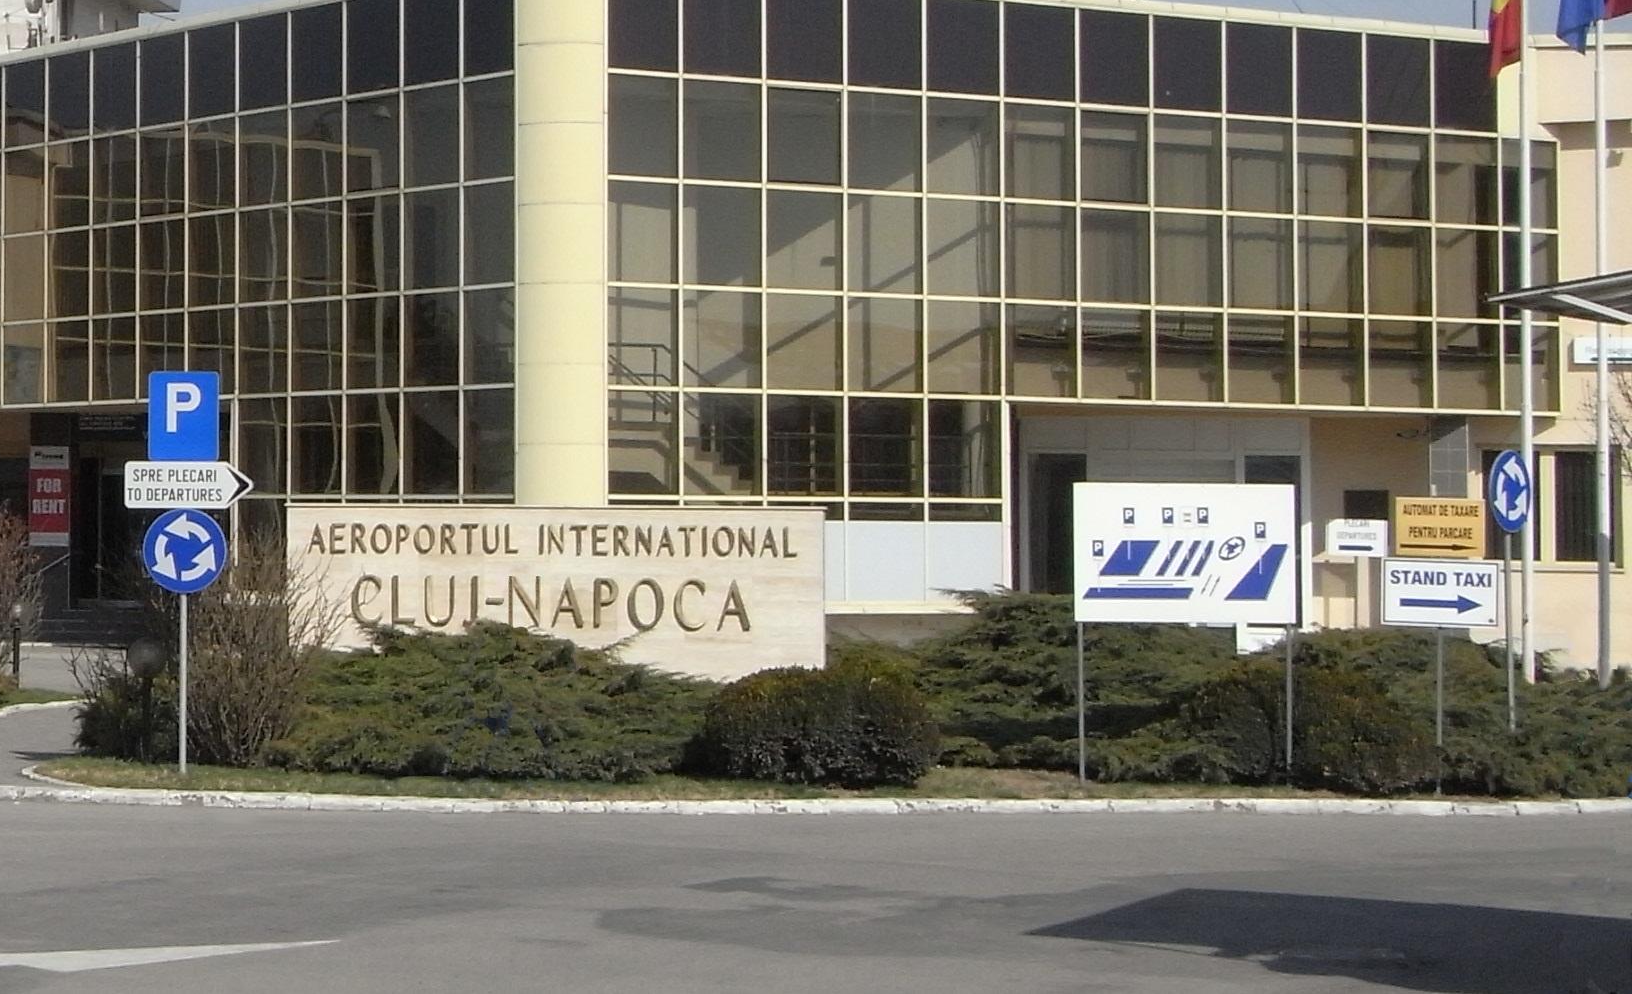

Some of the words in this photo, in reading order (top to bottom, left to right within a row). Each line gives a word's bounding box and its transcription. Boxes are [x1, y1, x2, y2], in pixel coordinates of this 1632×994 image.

[166, 382, 201, 433] P
[133, 469, 163, 482] SPRE
[168, 469, 217, 482] PLECARI
[36, 478, 62, 493] FOR
[128, 488, 142, 501] TO
[147, 488, 223, 502] DEPARTURES
[32, 499, 66, 514] RENT
[1403, 504, 1436, 516] AUTOMAT
[1439, 505, 1449, 516] DE
[1451, 505, 1479, 517] TAXARE
[1408, 526, 1438, 539] PENTRU
[1440, 527, 1473, 539] PARCARE
[307, 523, 518, 555] AEROPORTUL
[538, 524, 798, 558] INTERNATIONAL
[1390, 569, 1447, 586] STAND
[1453, 572, 1492, 587] TAXI
[351, 574, 752, 632] CLUJ-NAPOCA
